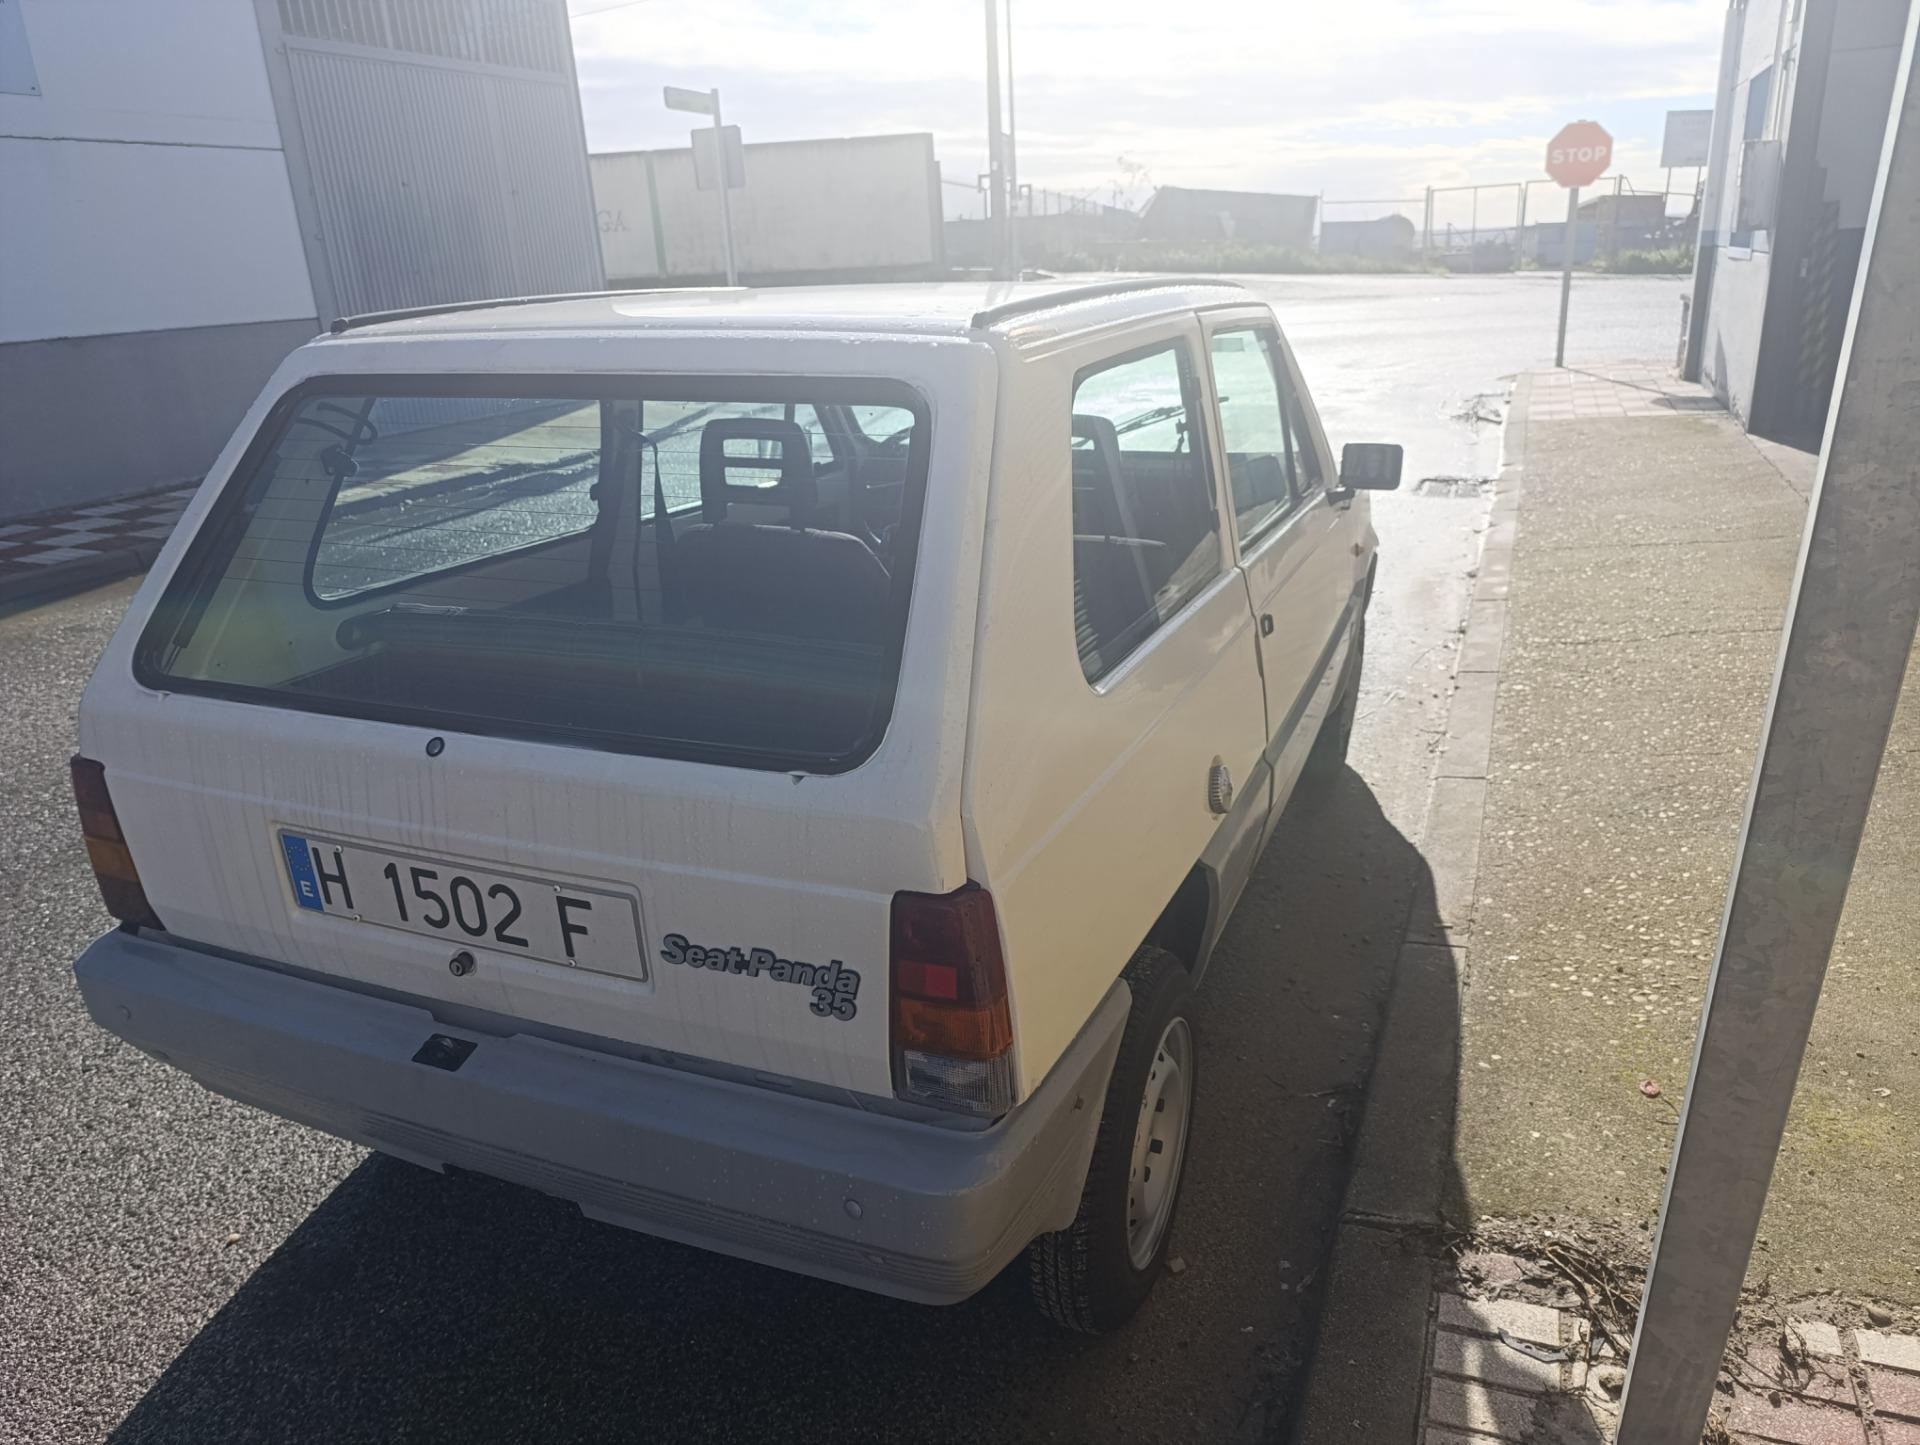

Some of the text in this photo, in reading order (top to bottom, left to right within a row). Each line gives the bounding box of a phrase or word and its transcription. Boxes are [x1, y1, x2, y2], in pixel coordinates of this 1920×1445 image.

[1551, 145, 1608, 165] STOP
[300, 880, 314, 898] E
[311, 846, 593, 958] H 1502 F
[809, 987, 858, 1022] 35
